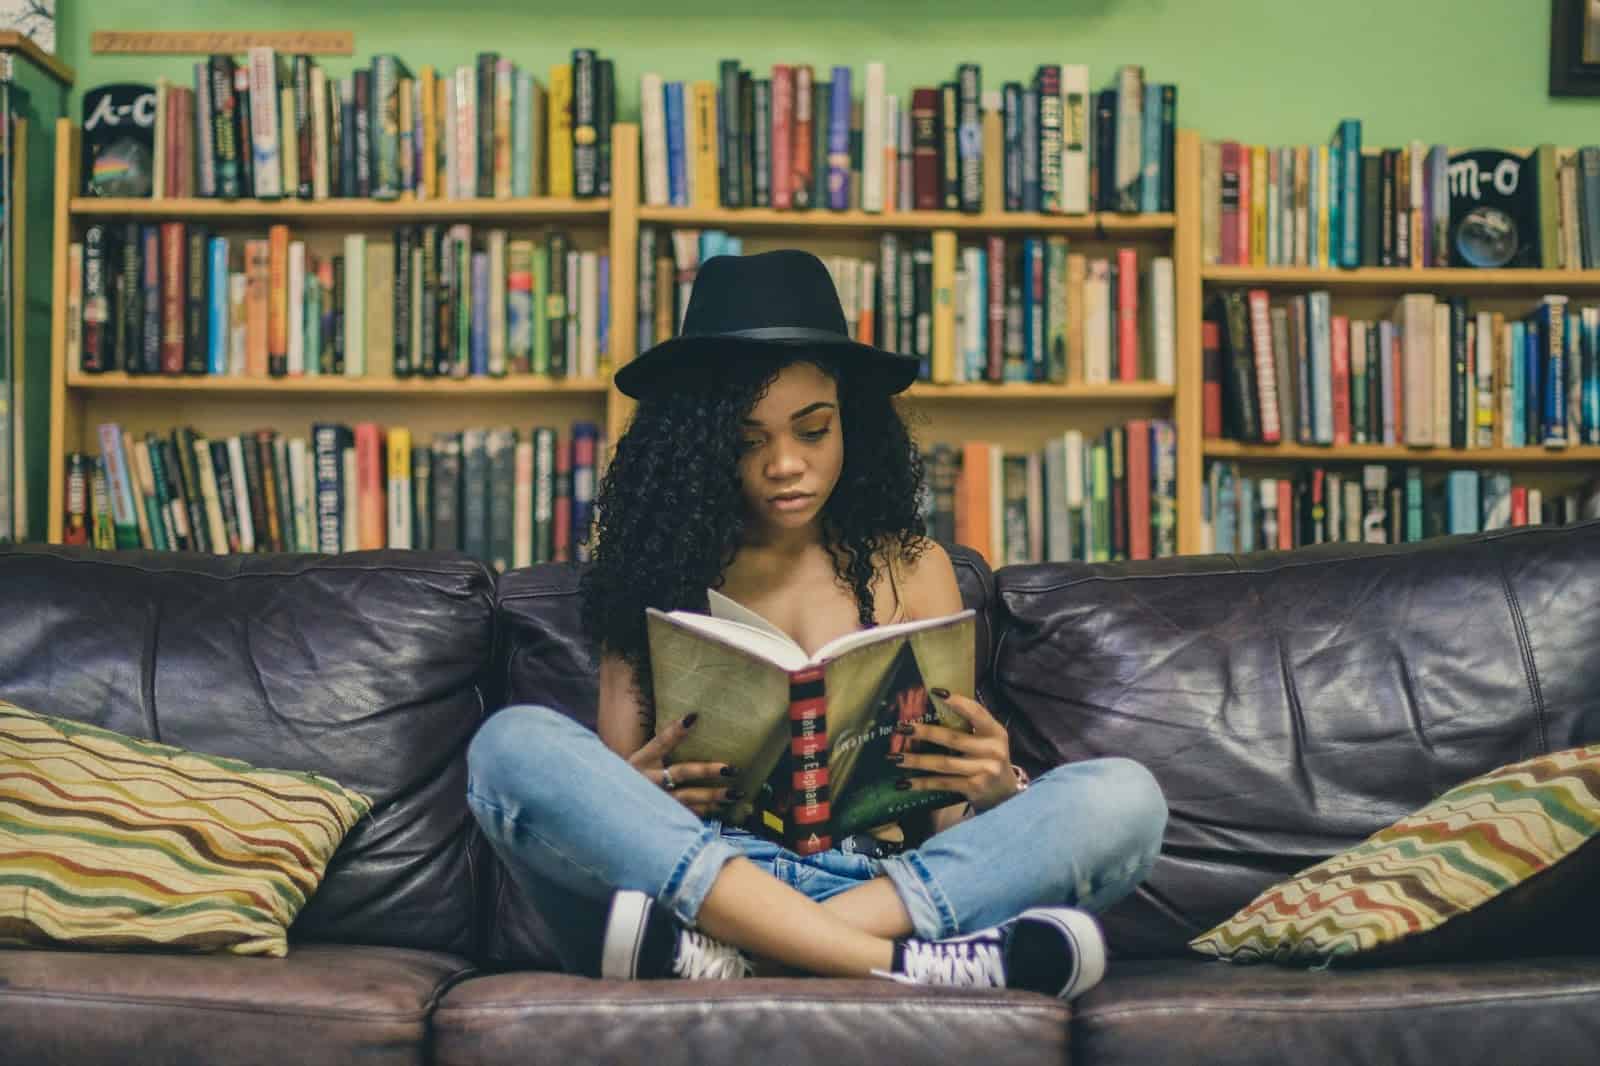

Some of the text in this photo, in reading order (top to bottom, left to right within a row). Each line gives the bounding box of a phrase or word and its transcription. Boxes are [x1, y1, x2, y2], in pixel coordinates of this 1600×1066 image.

[802, 709, 820, 817] Water for Elephants
[840, 731, 876, 752] Water
[879, 724, 894, 737] for
